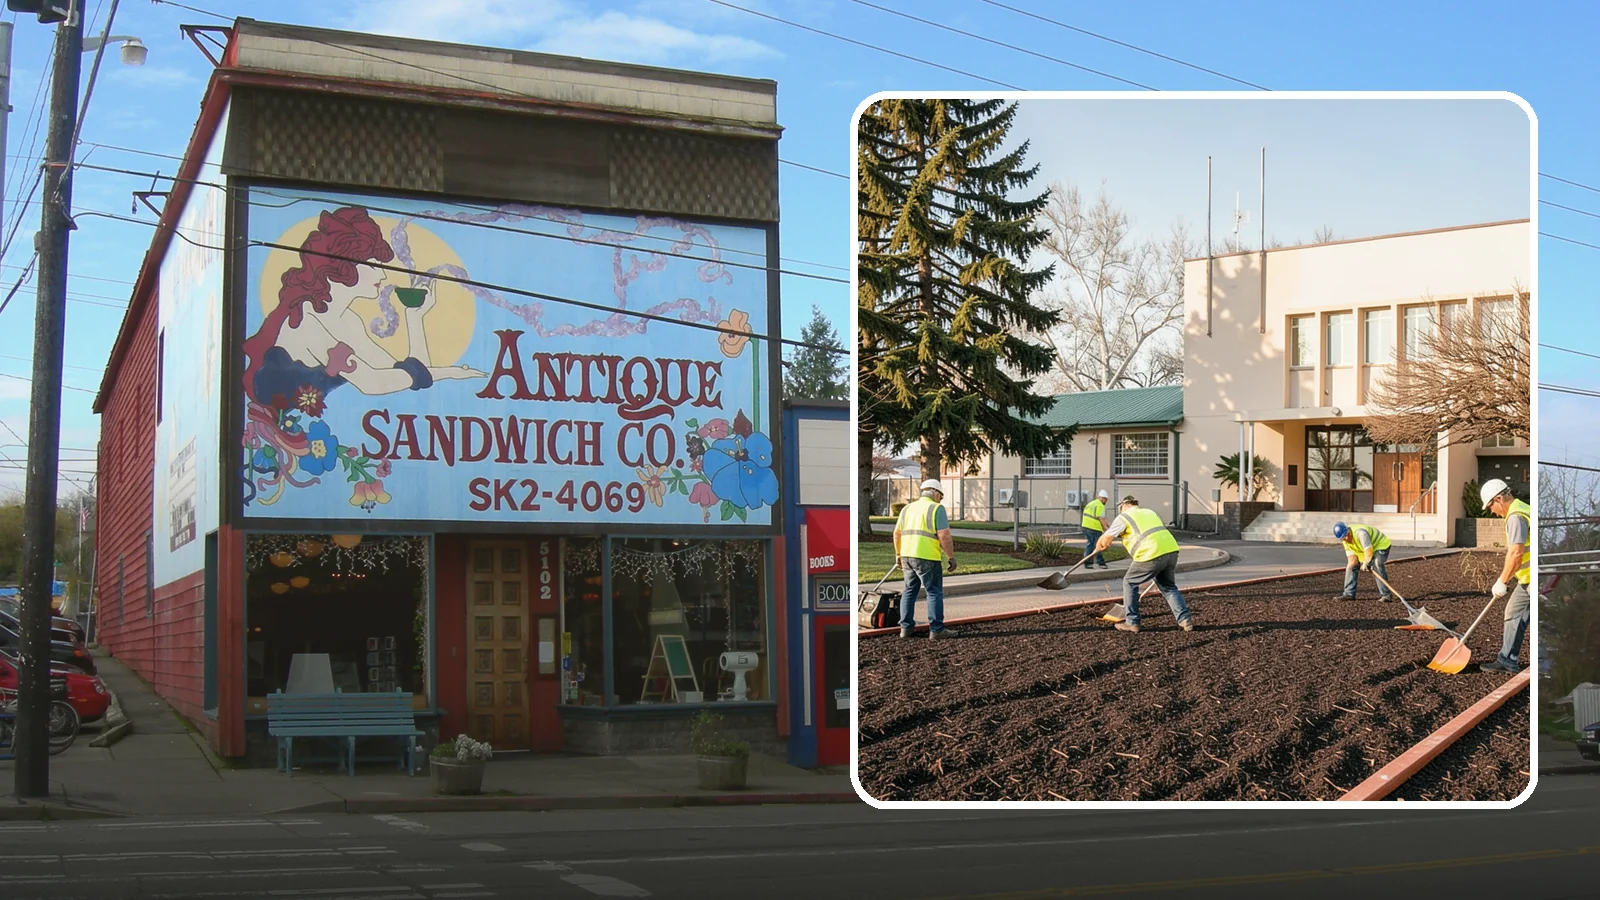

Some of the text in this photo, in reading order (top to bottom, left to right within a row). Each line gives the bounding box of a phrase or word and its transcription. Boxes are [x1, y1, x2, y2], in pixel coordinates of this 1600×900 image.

[476, 329, 723, 421] ANTIQUE
[361, 408, 685, 469] SANDWICH CO.
[468, 476, 646, 512] SK2-4069
[540, 541, 552, 600] 5102
[809, 555, 835, 569] BOOKS
